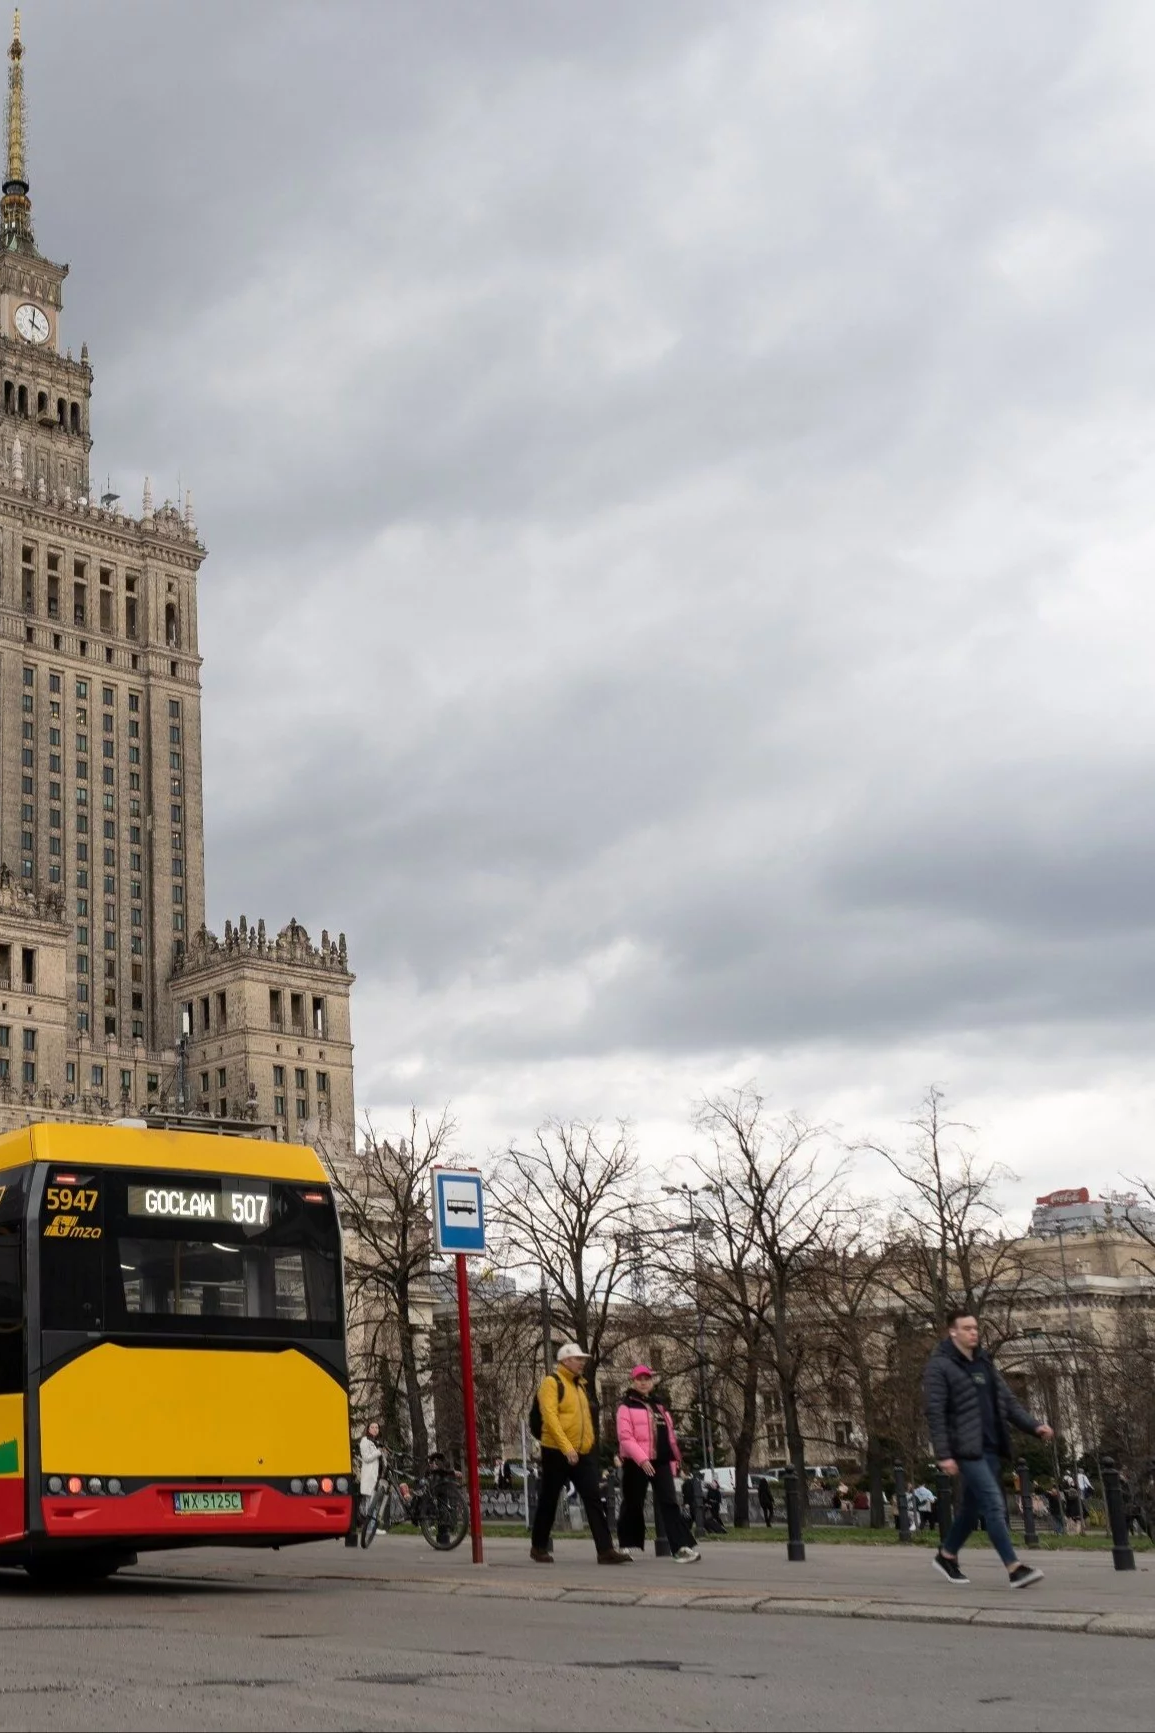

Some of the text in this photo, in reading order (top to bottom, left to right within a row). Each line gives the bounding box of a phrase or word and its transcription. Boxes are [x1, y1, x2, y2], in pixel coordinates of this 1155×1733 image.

[47, 1188, 98, 1211] 5947
[145, 1190, 268, 1224] GOCŁAW 507
[69, 1227, 102, 1239] mza
[182, 1494, 199, 1509] WX
[202, 1494, 239, 1509] 5125C
